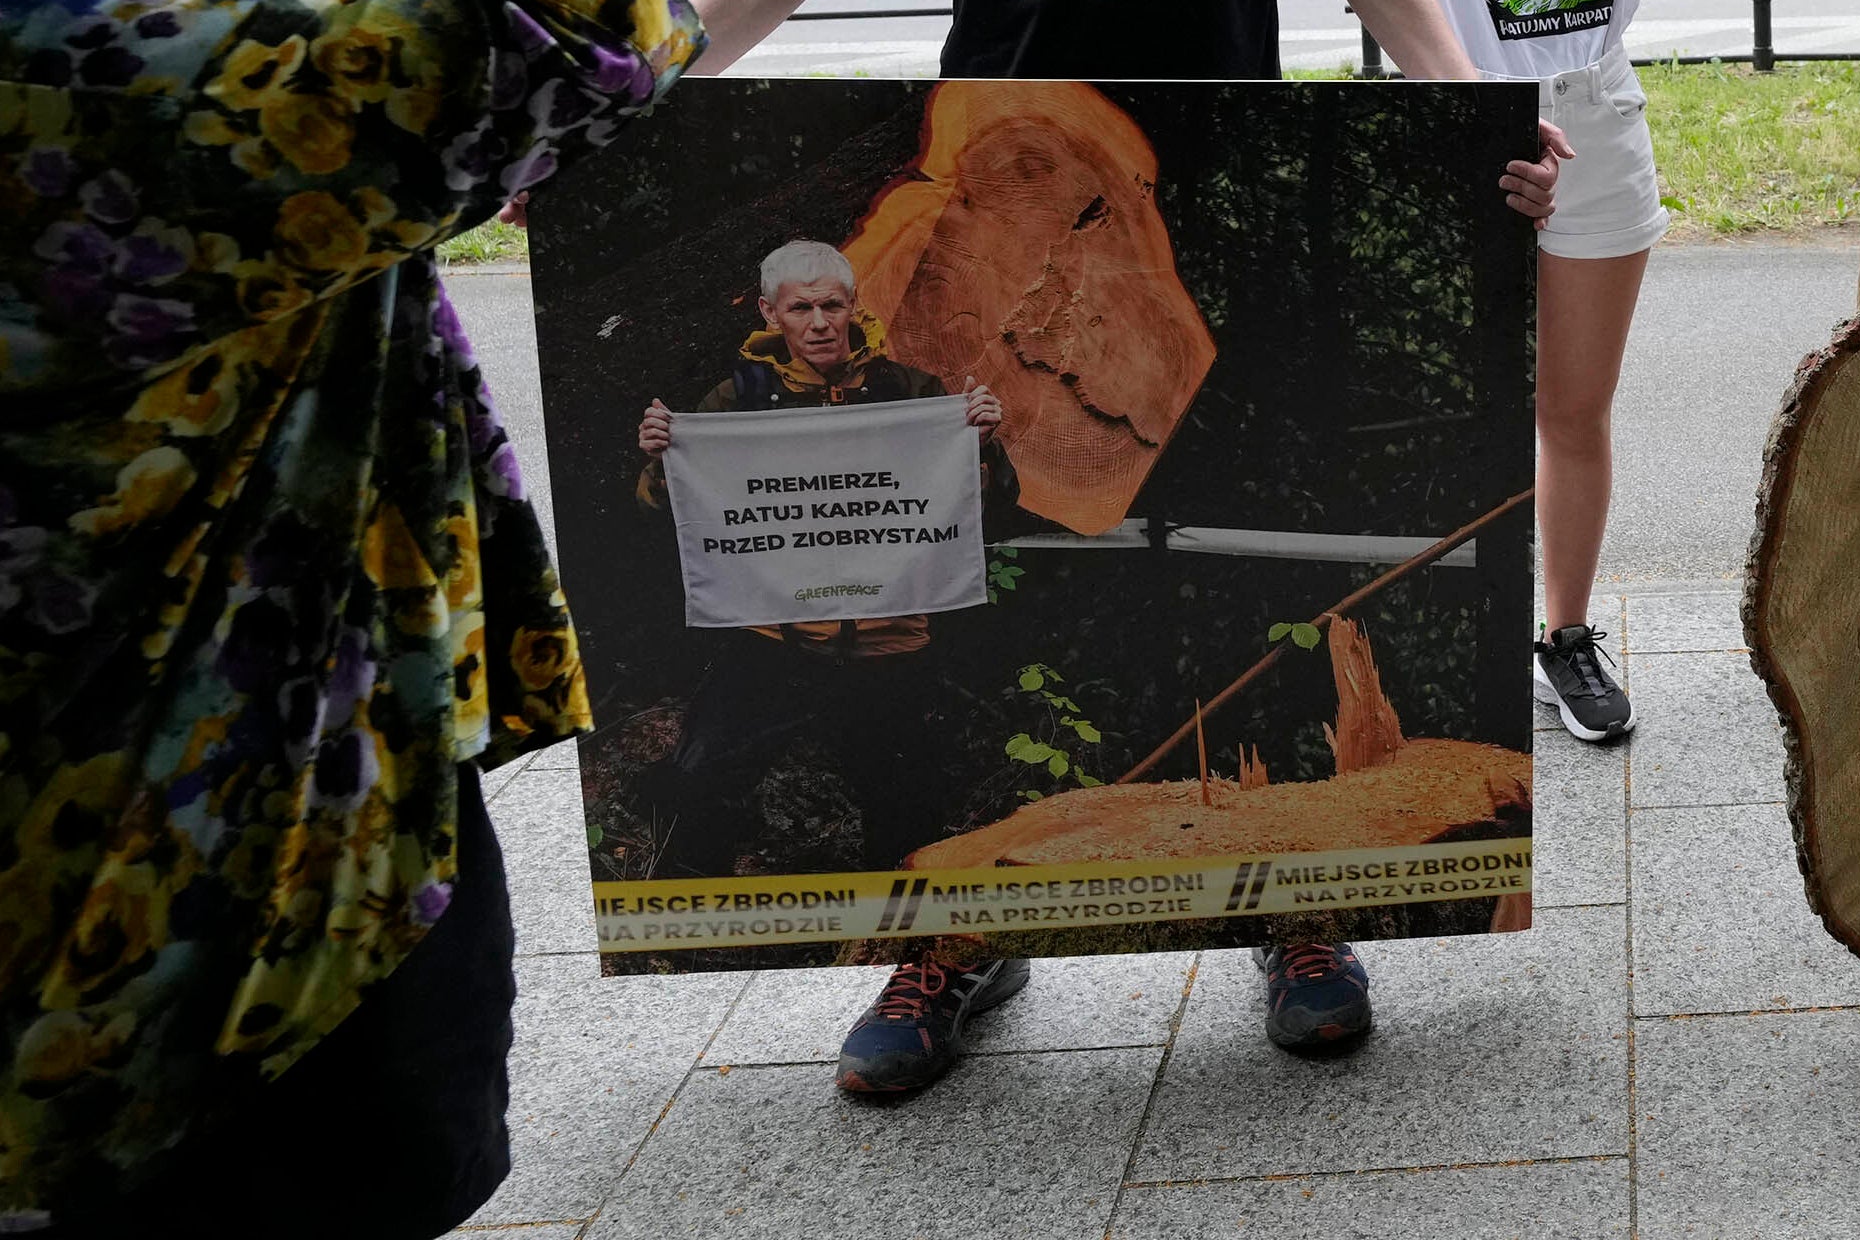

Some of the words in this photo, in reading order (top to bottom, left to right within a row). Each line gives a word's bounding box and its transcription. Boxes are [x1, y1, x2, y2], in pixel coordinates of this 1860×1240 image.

[747, 471, 900, 494] PREMIERZE,
[724, 505, 803, 526] RATUJ
[811, 499, 929, 519] KARPATY
[703, 533, 785, 554] PRZED
[793, 524, 959, 548] ZIOBRYSTAMI
[794, 584, 883, 602] GREENPEACE
[1276, 863, 1399, 886] MIEJSCE
[1405, 852, 1532, 877] ZBRODNI
[932, 881, 1062, 904] MIEJSCE
[1070, 872, 1204, 898] ZBRODNI
[1293, 886, 1336, 904] NA
[1345, 873, 1523, 902] PRZYRODZIE
[594, 895, 705, 918] IEJSCE
[714, 889, 856, 915] ZBRODNI
[950, 909, 999, 926] NA
[1004, 898, 1192, 923] PRZYRODZIE
[644, 916, 843, 941] PRZYRODZIE
